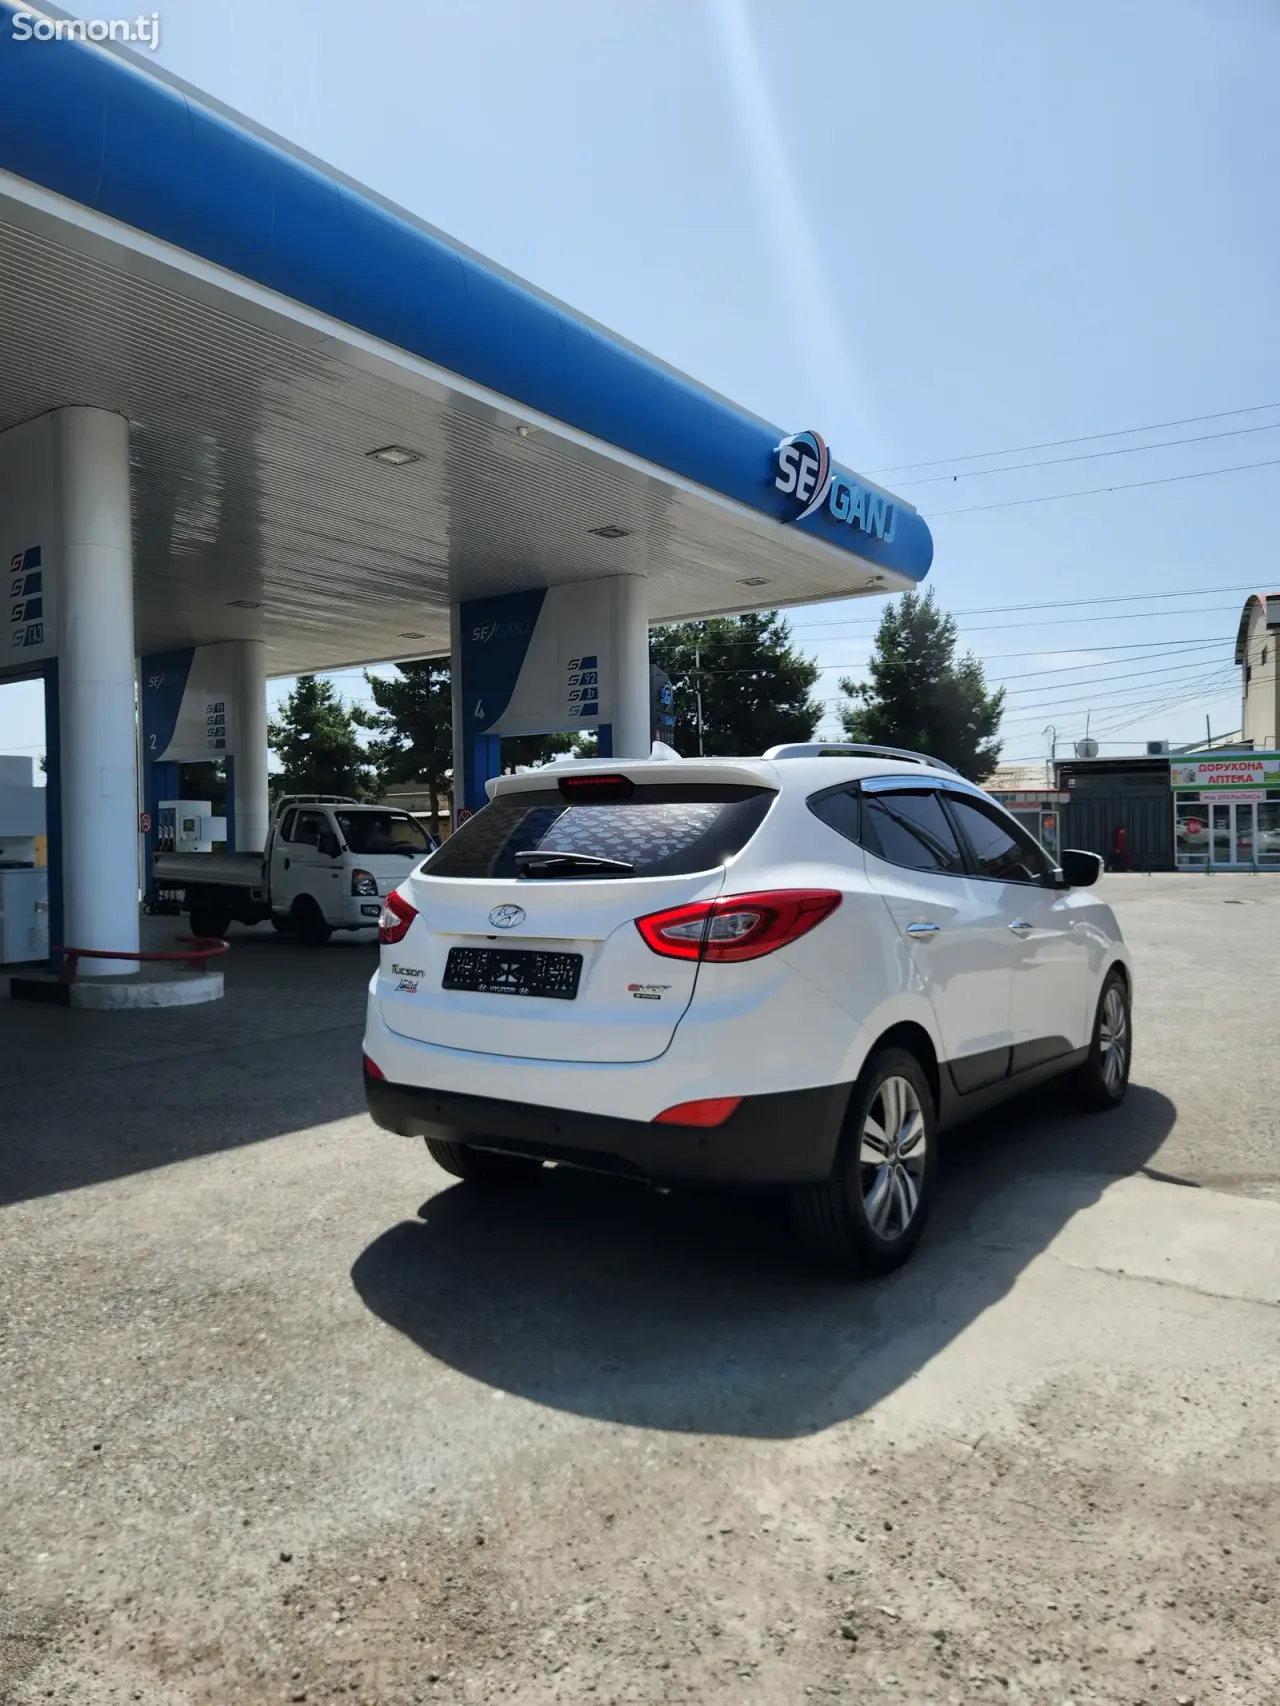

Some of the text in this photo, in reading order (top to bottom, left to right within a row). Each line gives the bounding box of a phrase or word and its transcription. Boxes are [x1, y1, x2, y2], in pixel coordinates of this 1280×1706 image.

[585, 673, 596, 684] 92
[474, 698, 485, 720] 4
[150, 734, 157, 750] 2
[1198, 762, 1264, 773] ДОРУХОНА
[1208, 774, 1254, 784] АПТЕКА
[392, 964, 425, 978] Tucson
[489, 986, 516, 994] HYUNDAI
